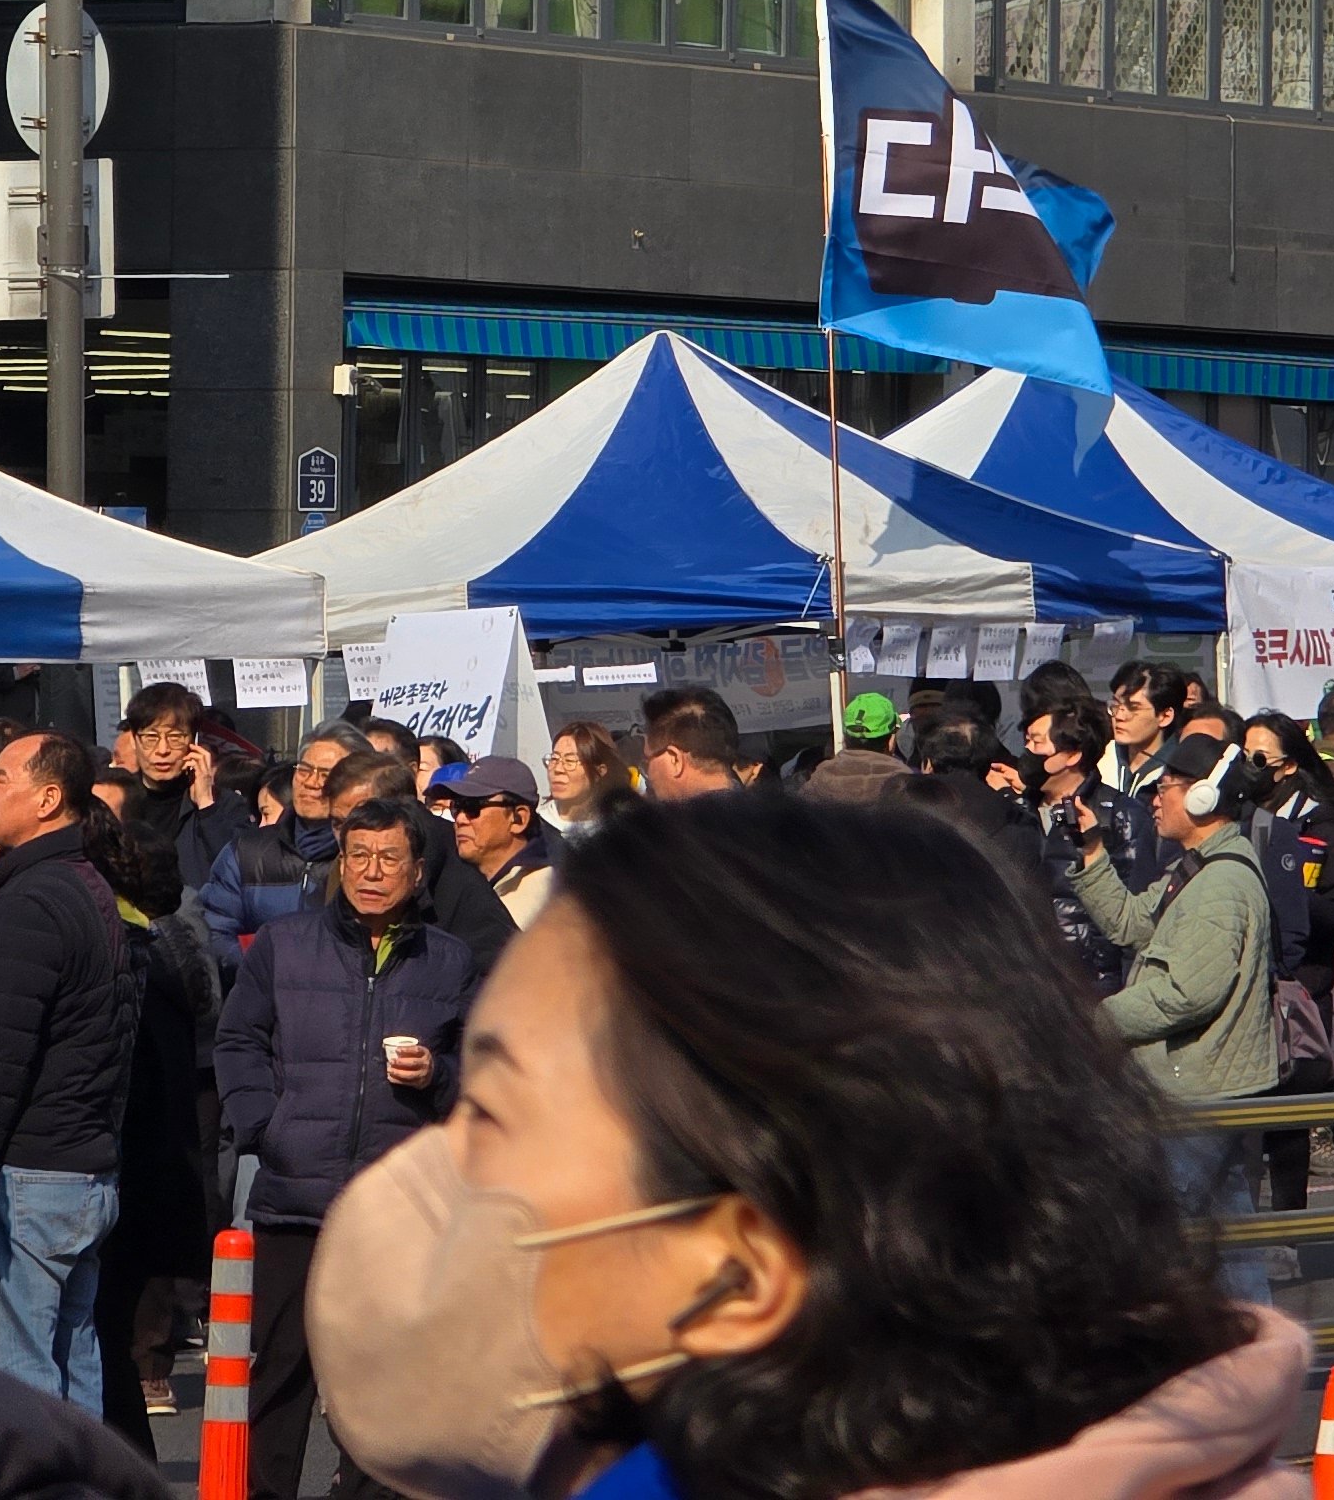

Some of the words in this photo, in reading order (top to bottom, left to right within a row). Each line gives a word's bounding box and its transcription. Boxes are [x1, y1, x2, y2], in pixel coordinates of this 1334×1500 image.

[309, 479, 326, 503] 39
[1252, 627, 1331, 670] 후쿠시마
[379, 680, 449, 709] 내란종결자
[406, 695, 493, 741] 이재명
